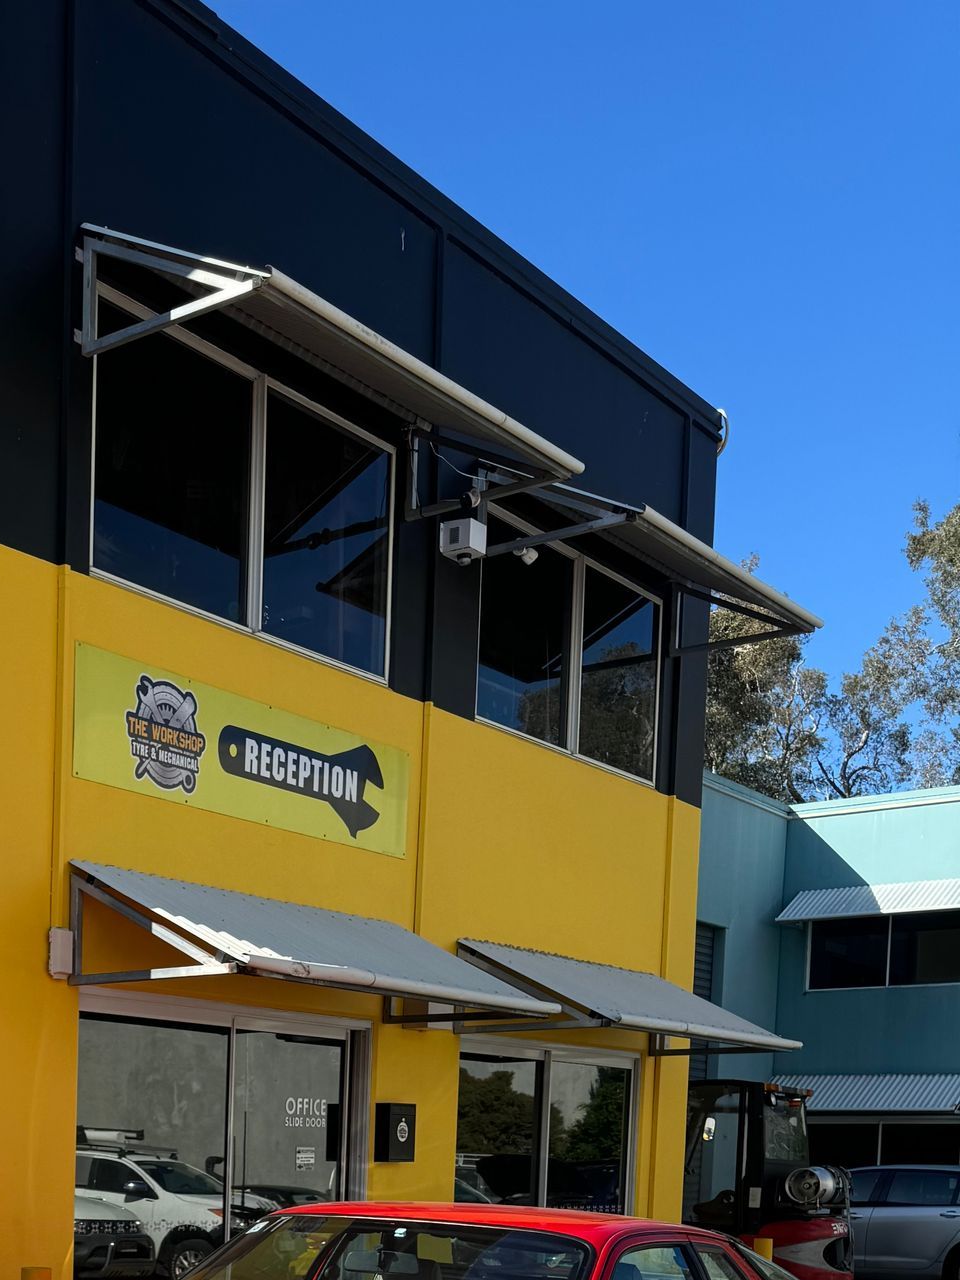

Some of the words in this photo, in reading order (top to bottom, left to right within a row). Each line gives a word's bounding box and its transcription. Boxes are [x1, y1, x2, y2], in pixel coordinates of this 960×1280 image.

[128, 717, 149, 737] THE
[152, 723, 204, 752] WORKSHOP
[132, 741, 149, 758] TYRE
[158, 749, 199, 771] MECHANICAL
[244, 737, 359, 803] RECEPTION
[285, 1097, 327, 1116] OFFICE
[285, 1116, 303, 1127] SLIDE
[305, 1117, 326, 1128] DOOR
